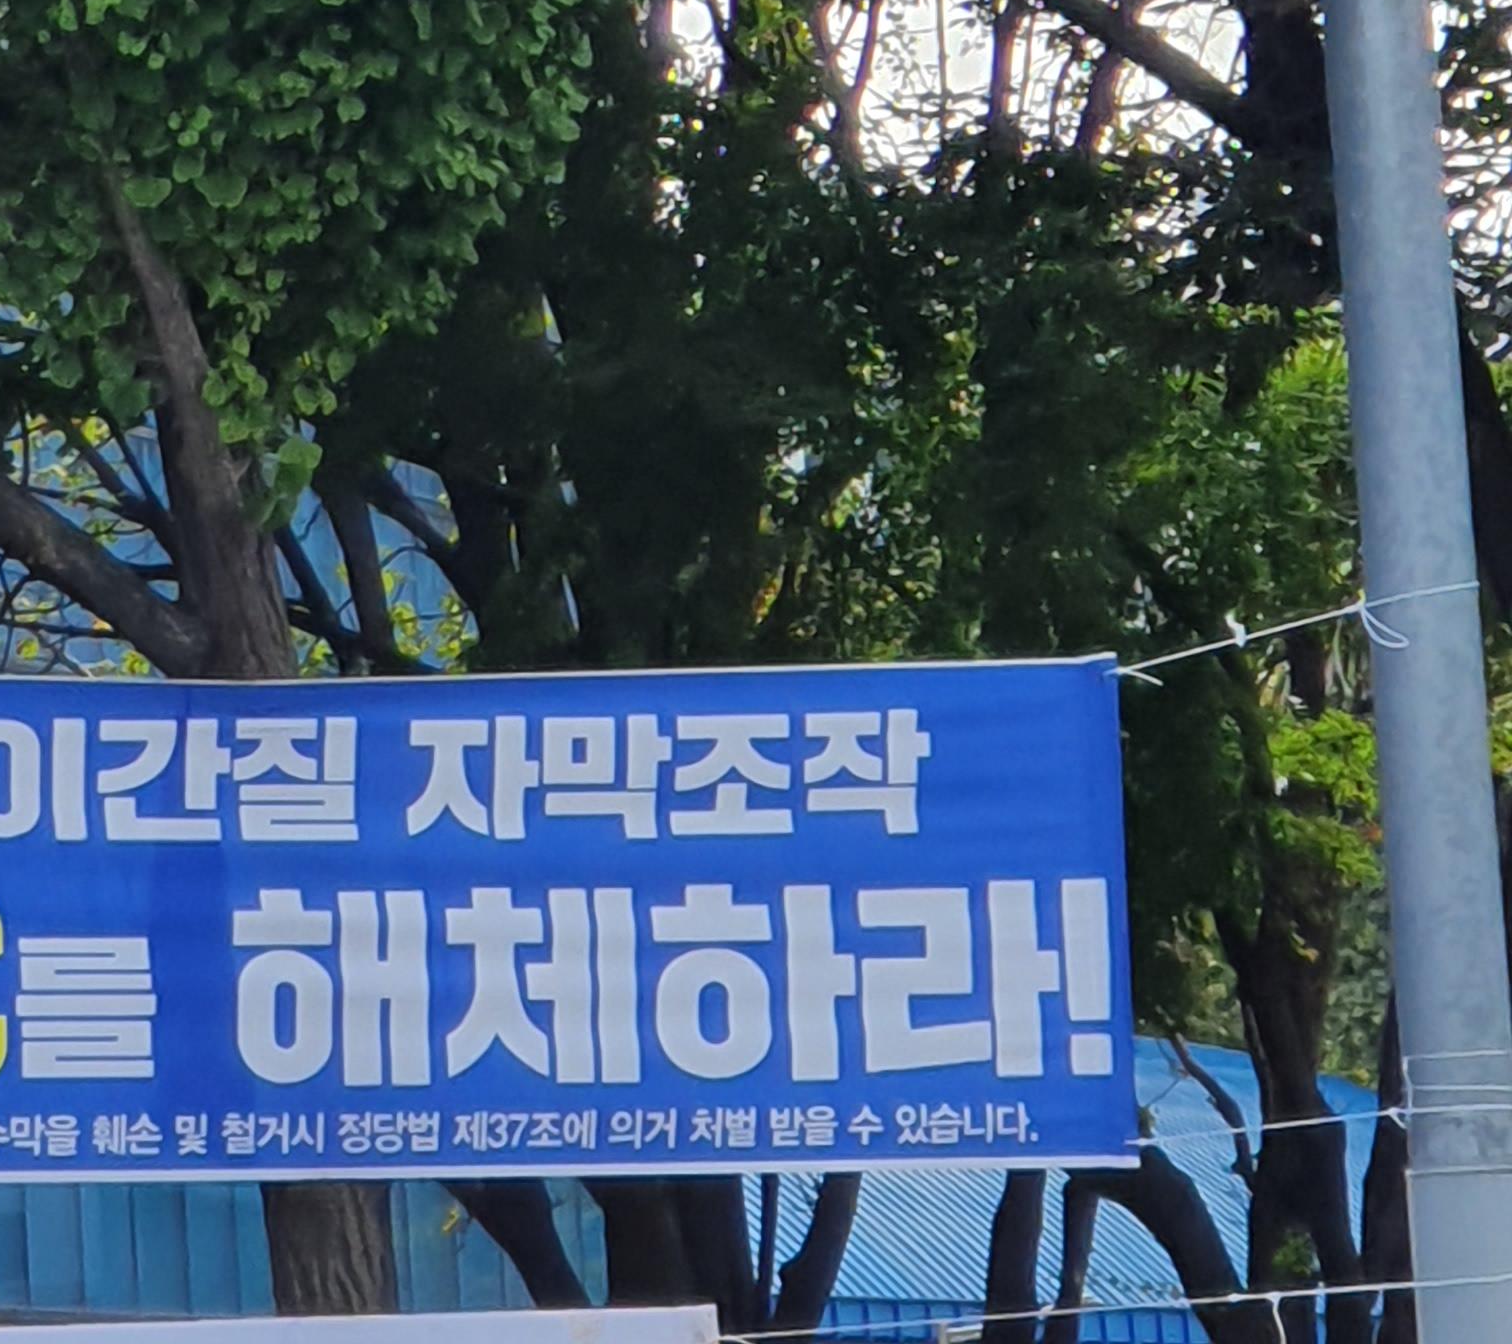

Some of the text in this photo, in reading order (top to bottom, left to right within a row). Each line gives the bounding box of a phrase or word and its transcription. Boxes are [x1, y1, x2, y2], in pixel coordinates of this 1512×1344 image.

[406, 708, 931, 841] 자막조작
[231, 877, 1114, 1087] 해체하라!
[174, 1113, 208, 1155] 및
[221, 1112, 325, 1155] 철거시
[337, 1111, 441, 1153] 정당법
[453, 1109, 597, 1152] 제37조에
[608, 1110, 678, 1150] 의거
[690, 1107, 757, 1149] 처벌
[769, 1106, 839, 1148] 받을
[847, 1108, 885, 1147] 수
[894, 1102, 1040, 1145] 있습니다.
